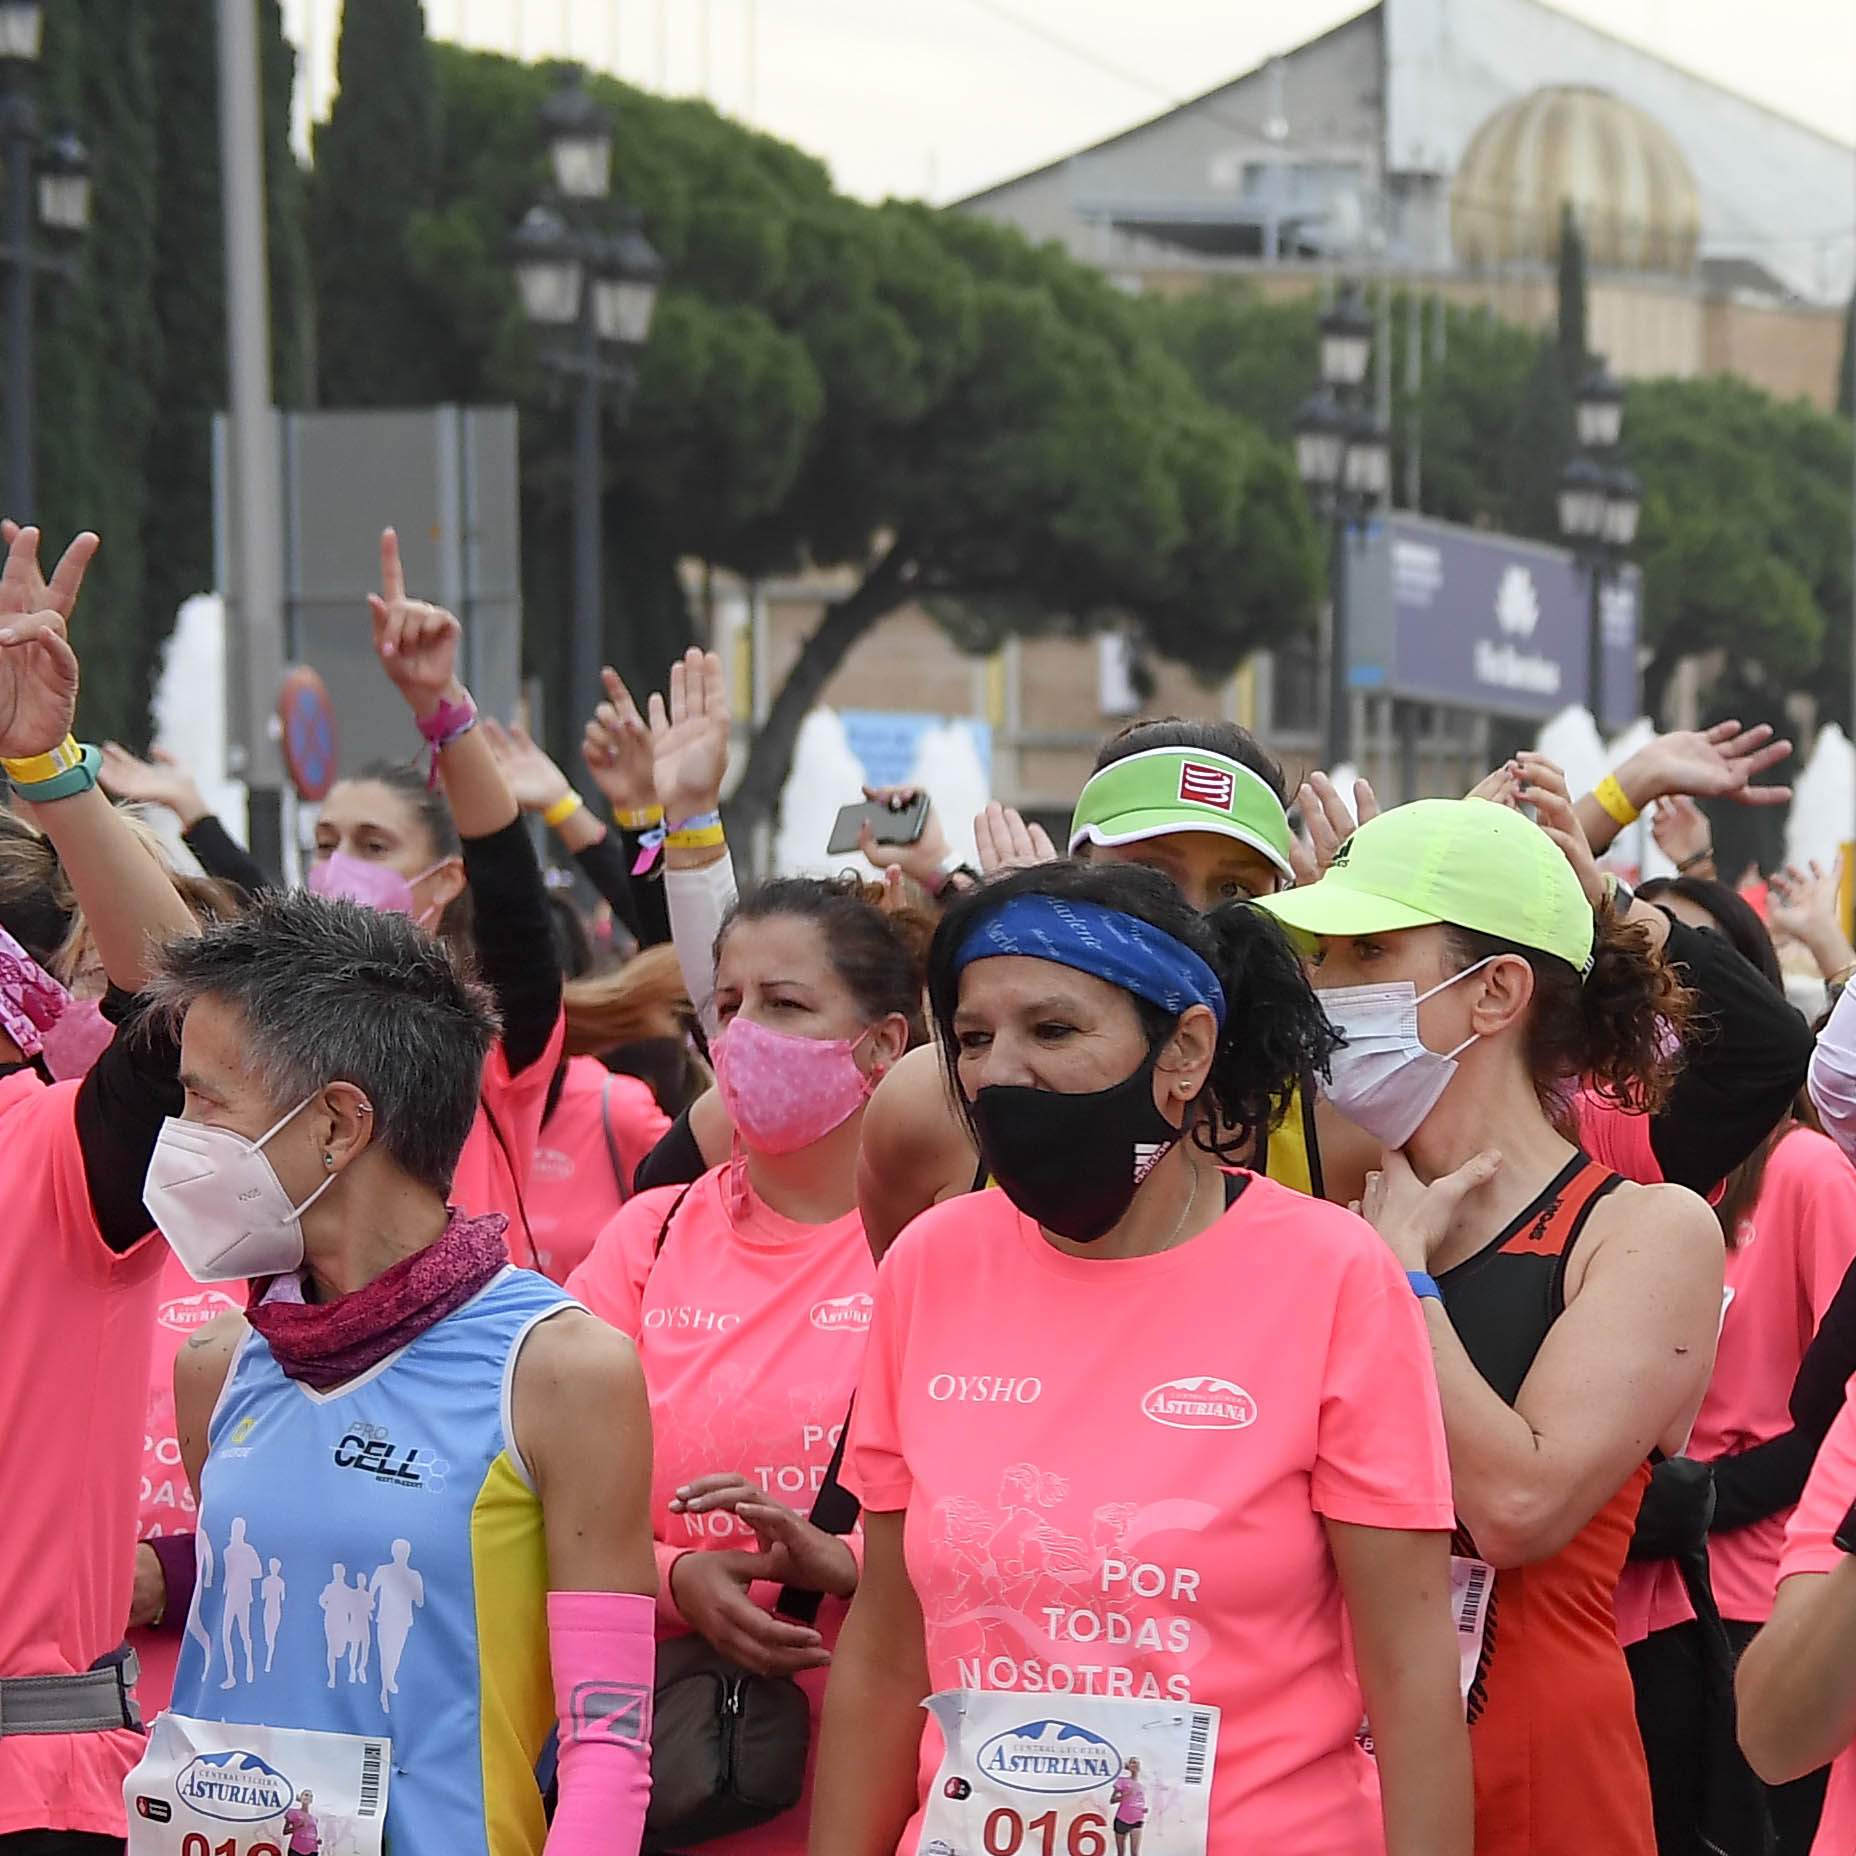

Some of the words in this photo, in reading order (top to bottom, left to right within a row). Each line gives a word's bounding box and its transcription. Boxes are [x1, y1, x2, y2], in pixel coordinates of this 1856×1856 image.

[927, 1373, 1042, 1404] OYSHO
[1150, 1392, 1248, 1422] ASTURIANA
[333, 1433, 421, 1481] CELL
[1101, 1558, 1201, 1602] POR
[1042, 1606, 1192, 1653] TODAS
[958, 1656, 1191, 1703] NOSOTRAS
[987, 1746, 1112, 1777] ASTURIANA
[182, 1773, 283, 1808] ASTURIANA
